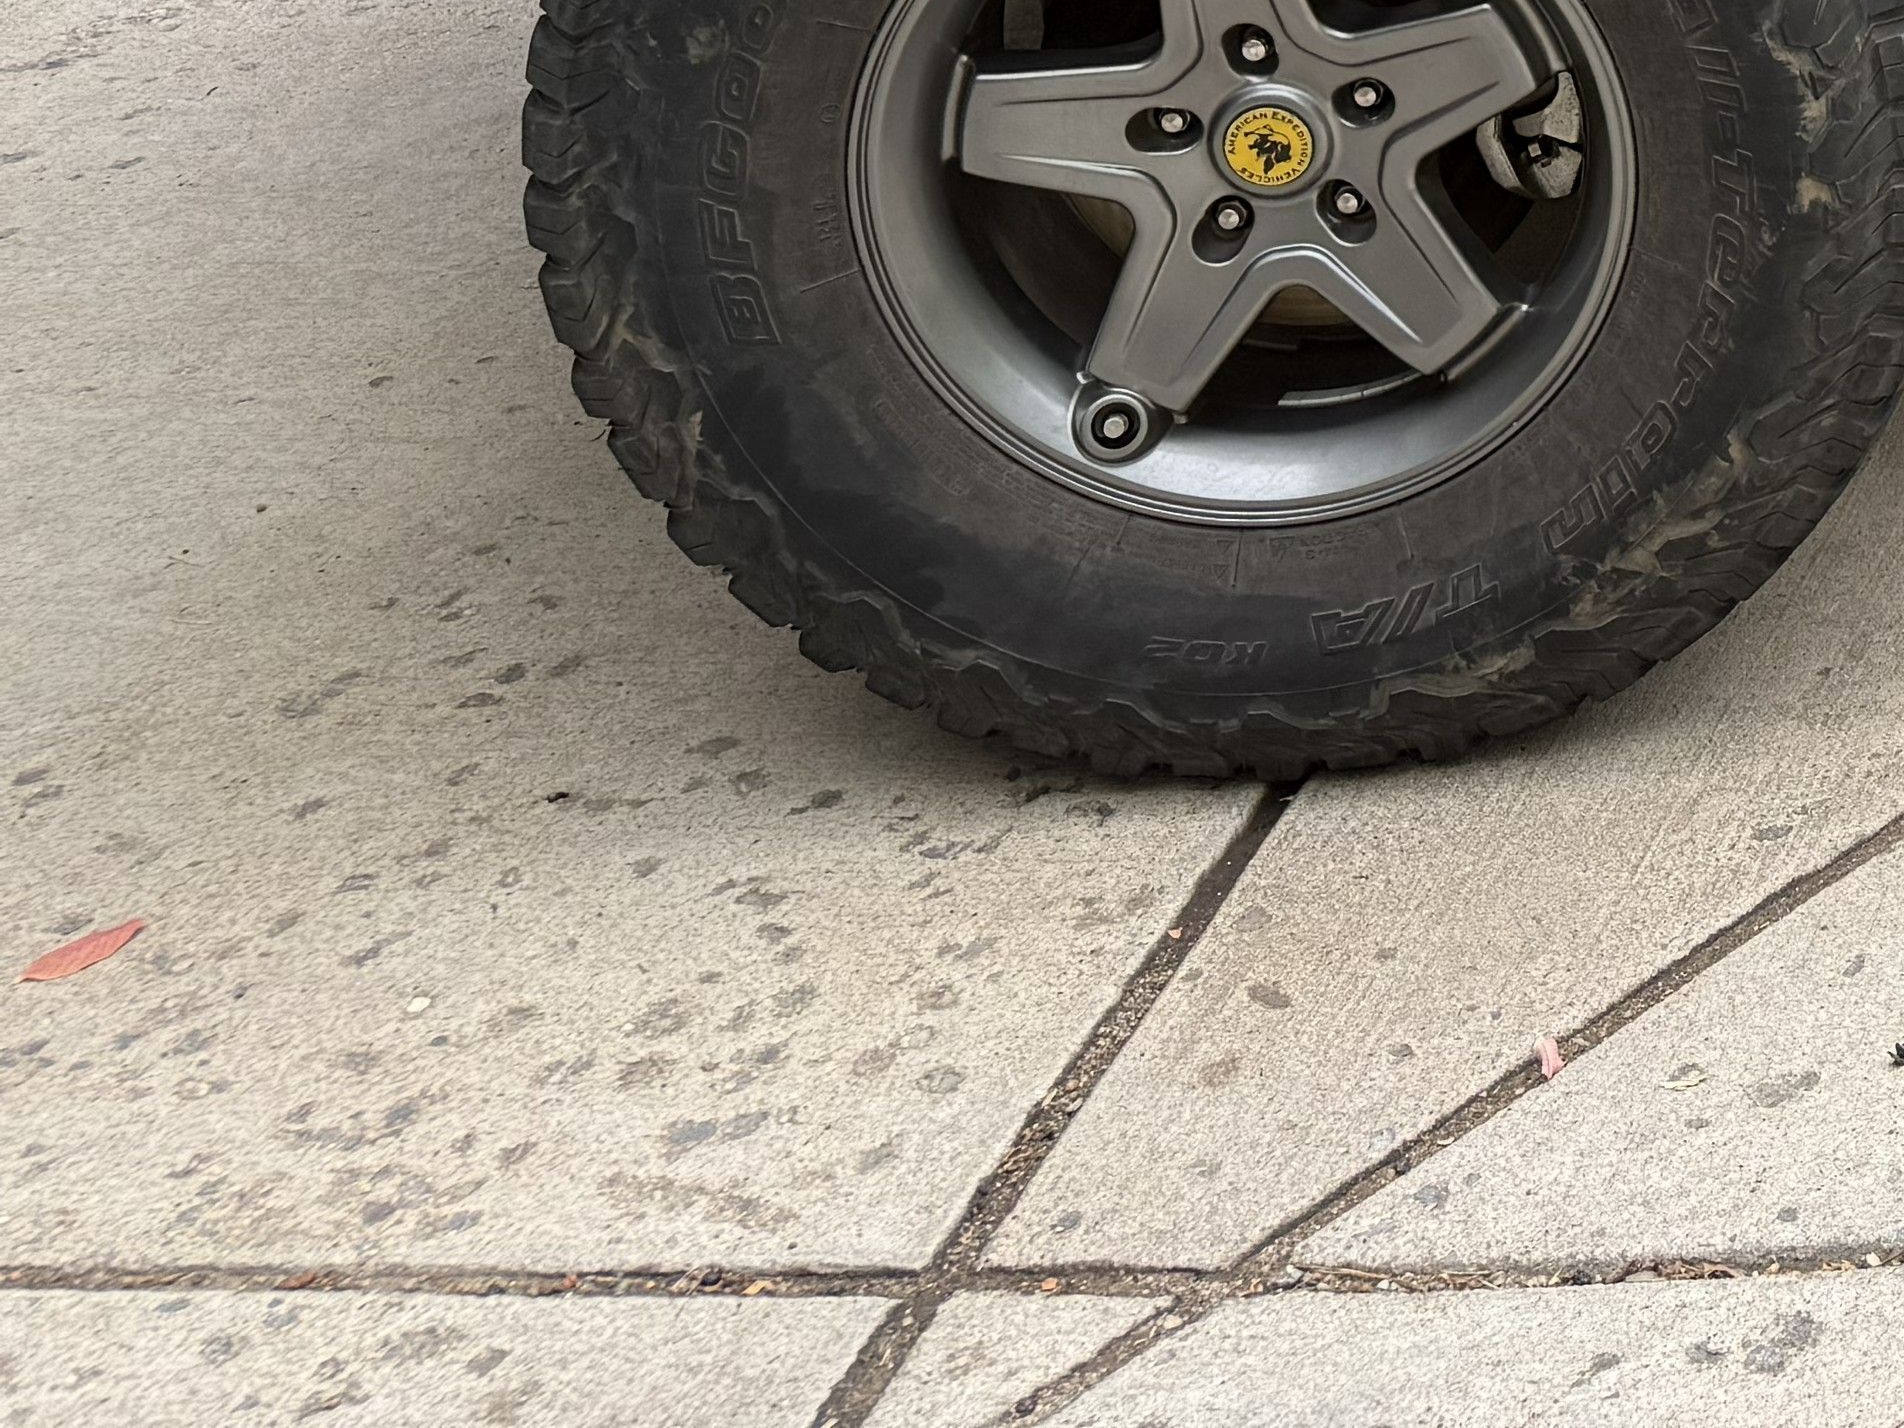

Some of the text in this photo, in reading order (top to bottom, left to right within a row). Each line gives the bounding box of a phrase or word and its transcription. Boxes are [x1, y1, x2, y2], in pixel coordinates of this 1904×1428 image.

[1227, 110, 1308, 183] AMERICAN EXPEDITION VEHICLES
[1309, 562, 1502, 655] T/A
